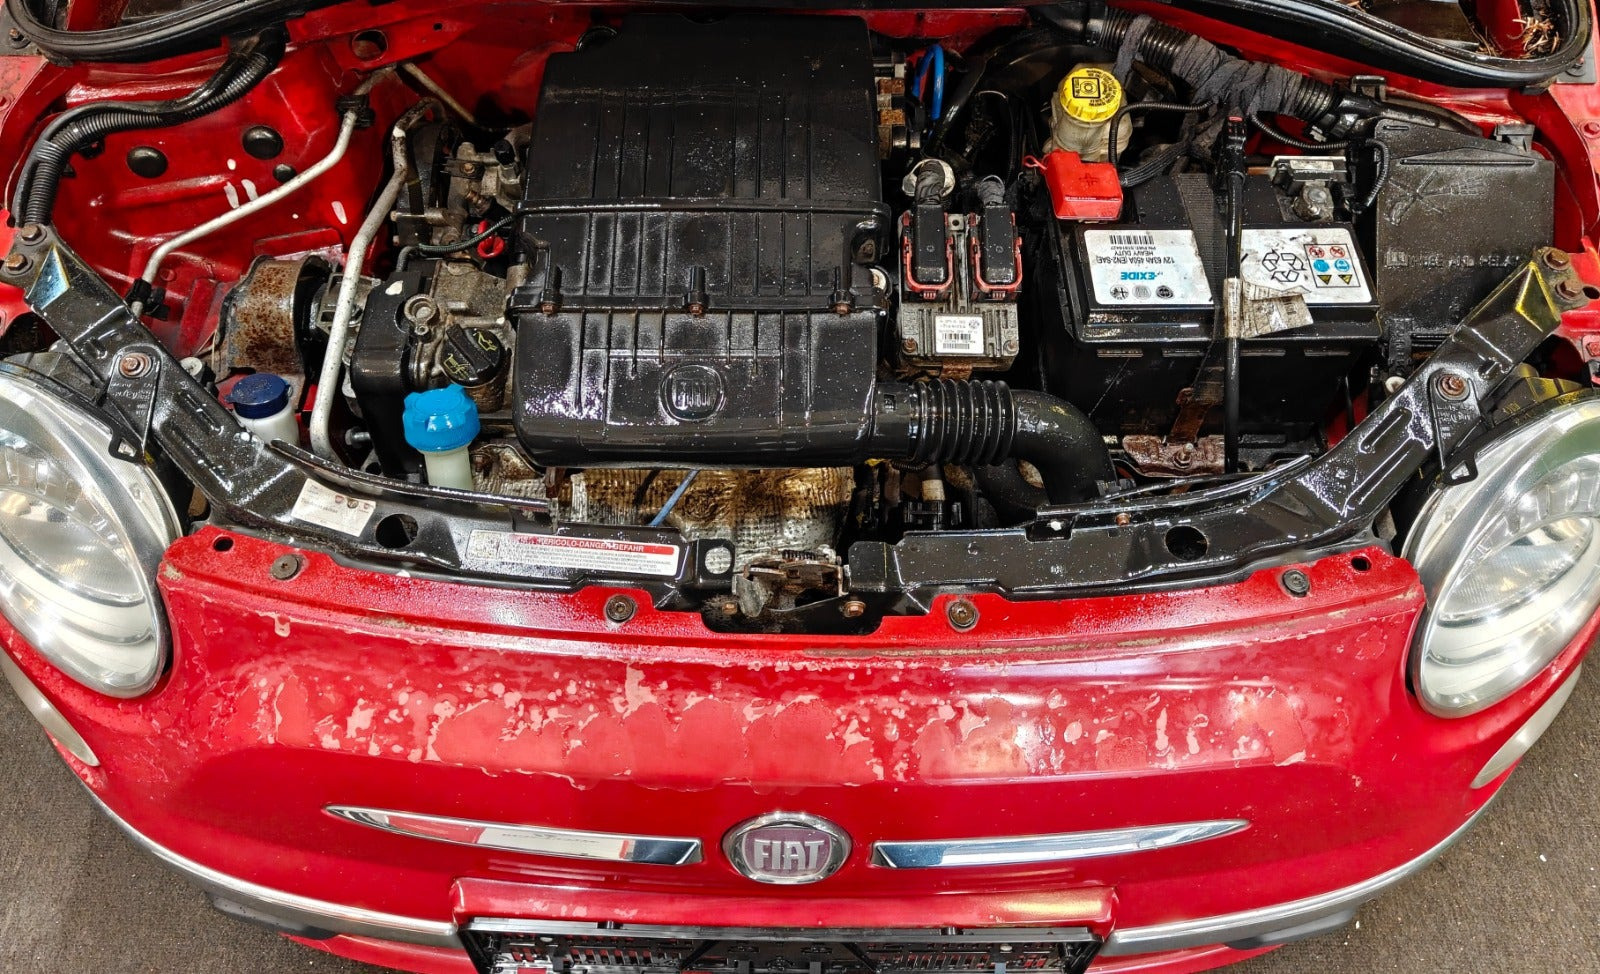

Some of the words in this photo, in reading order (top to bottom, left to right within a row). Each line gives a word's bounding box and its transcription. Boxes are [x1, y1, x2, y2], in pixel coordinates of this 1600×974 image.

[1163, 256, 1175, 264] 12V
[1120, 271, 1156, 281] EXIDE
[754, 839, 825, 870] FIAT
